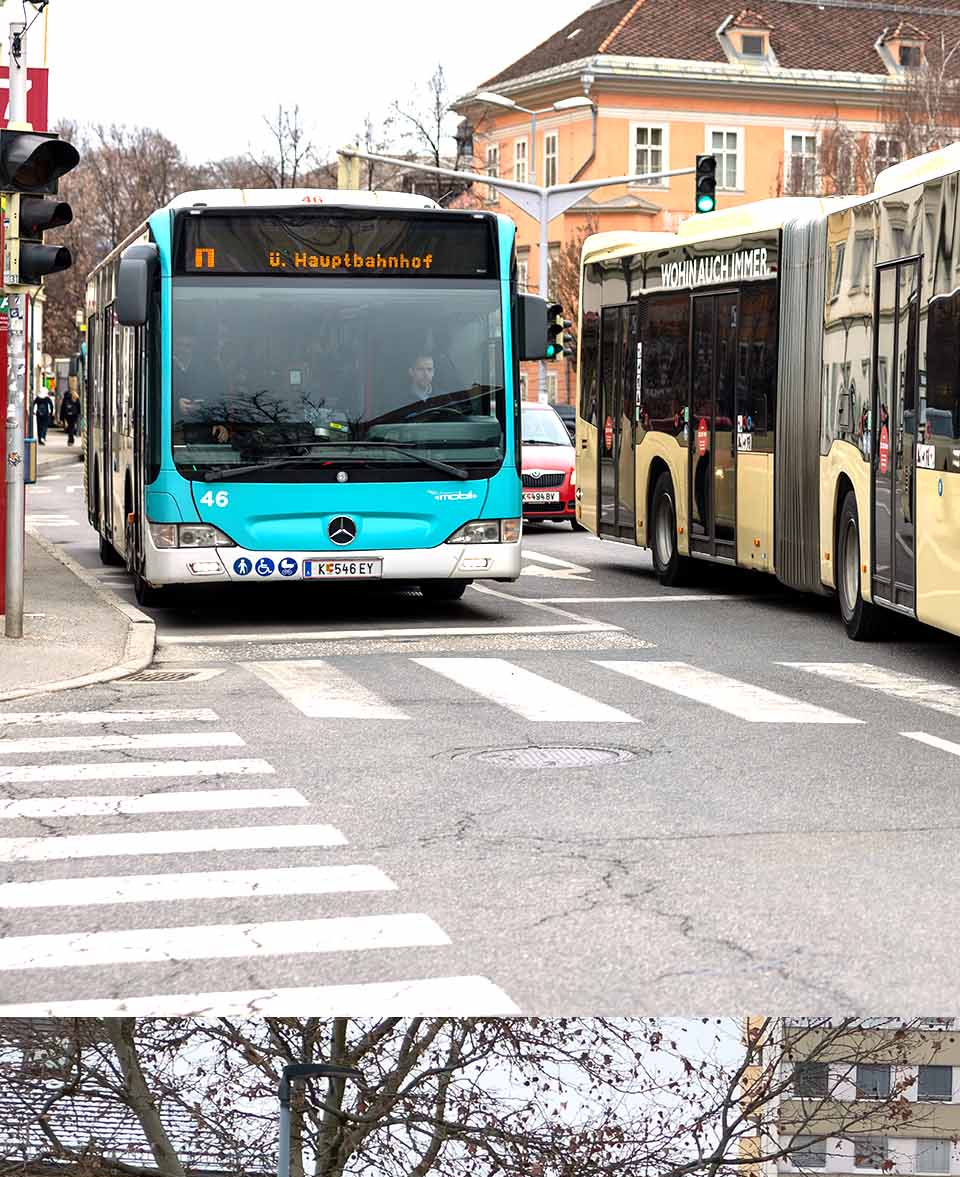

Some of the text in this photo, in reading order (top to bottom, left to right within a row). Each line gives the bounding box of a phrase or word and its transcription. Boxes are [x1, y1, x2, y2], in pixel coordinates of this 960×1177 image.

[269, 252, 433, 270] ü. Hauptbahnhof
[661, 247, 770, 289] WOHIN AUCH IMMER.
[200, 491, 229, 507] 46
[318, 563, 374, 575] K 546 EY
